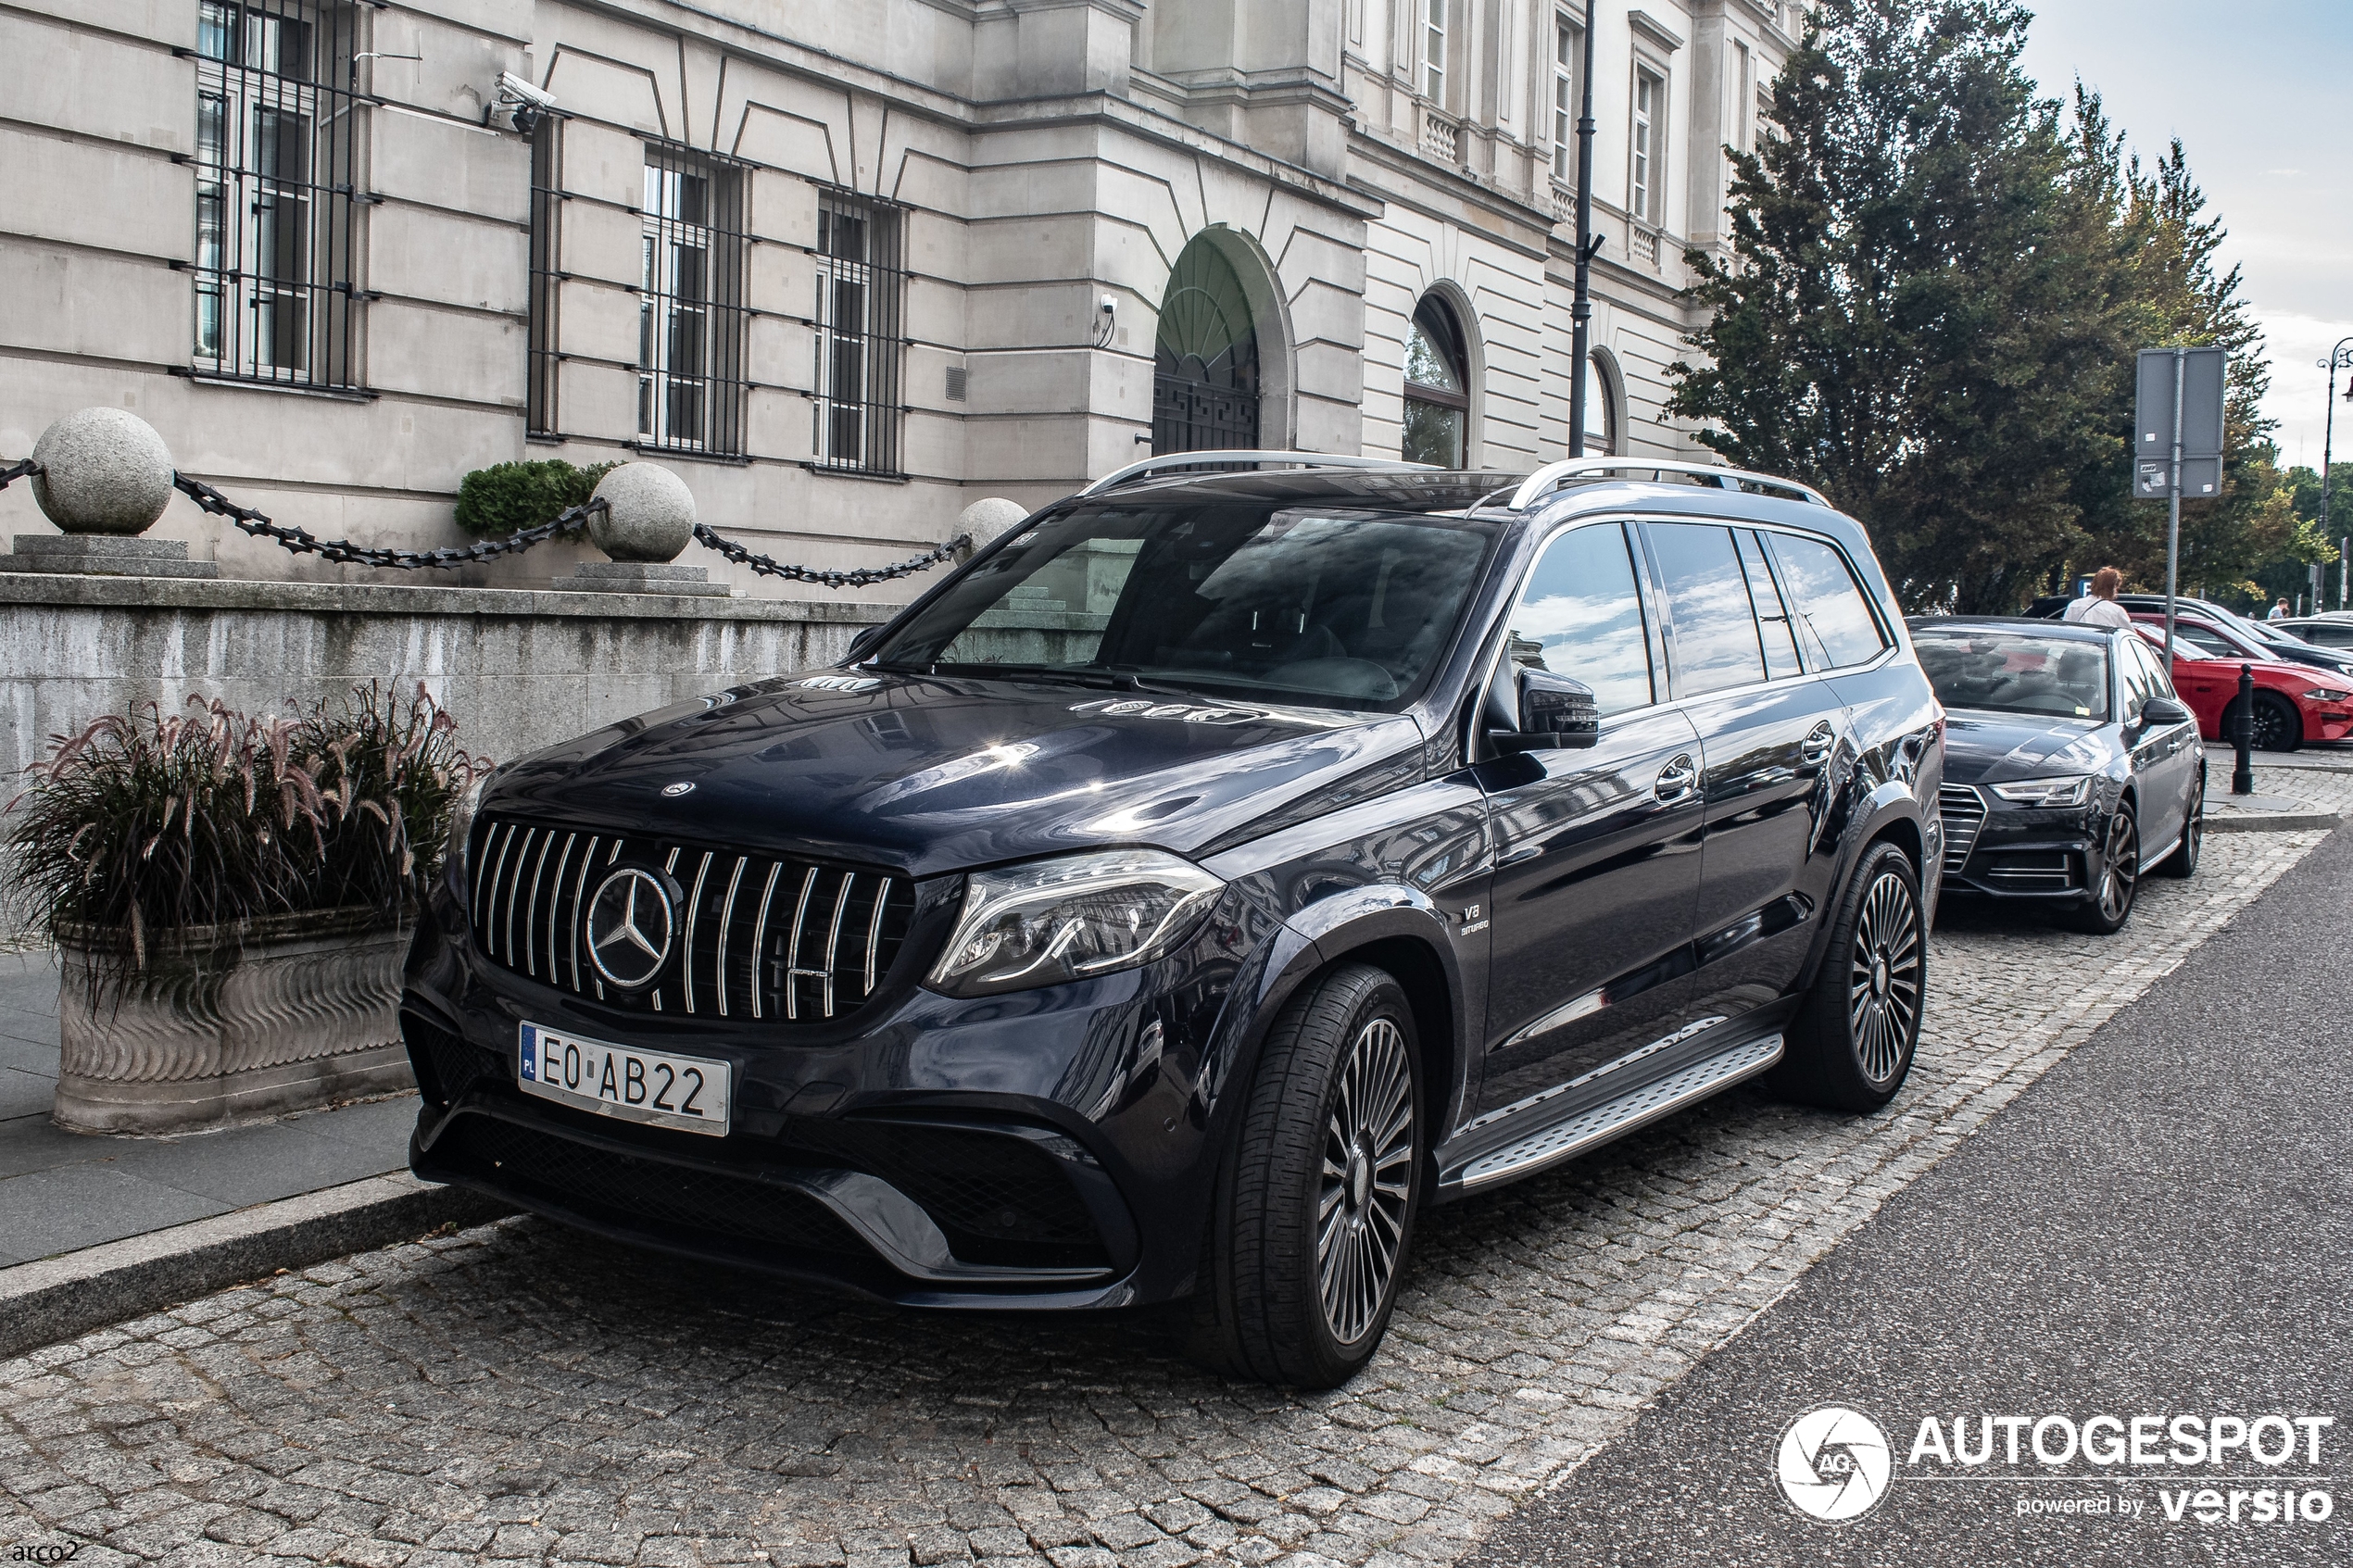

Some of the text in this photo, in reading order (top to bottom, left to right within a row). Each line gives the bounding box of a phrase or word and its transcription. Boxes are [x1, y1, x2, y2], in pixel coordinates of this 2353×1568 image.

[1464, 904, 1480, 921] V8
[1461, 919, 1490, 936] BITURBO
[1354, 993, 1379, 1027] ZERO
[523, 1059, 535, 1074] PL
[598, 1051, 706, 1117] AB22
